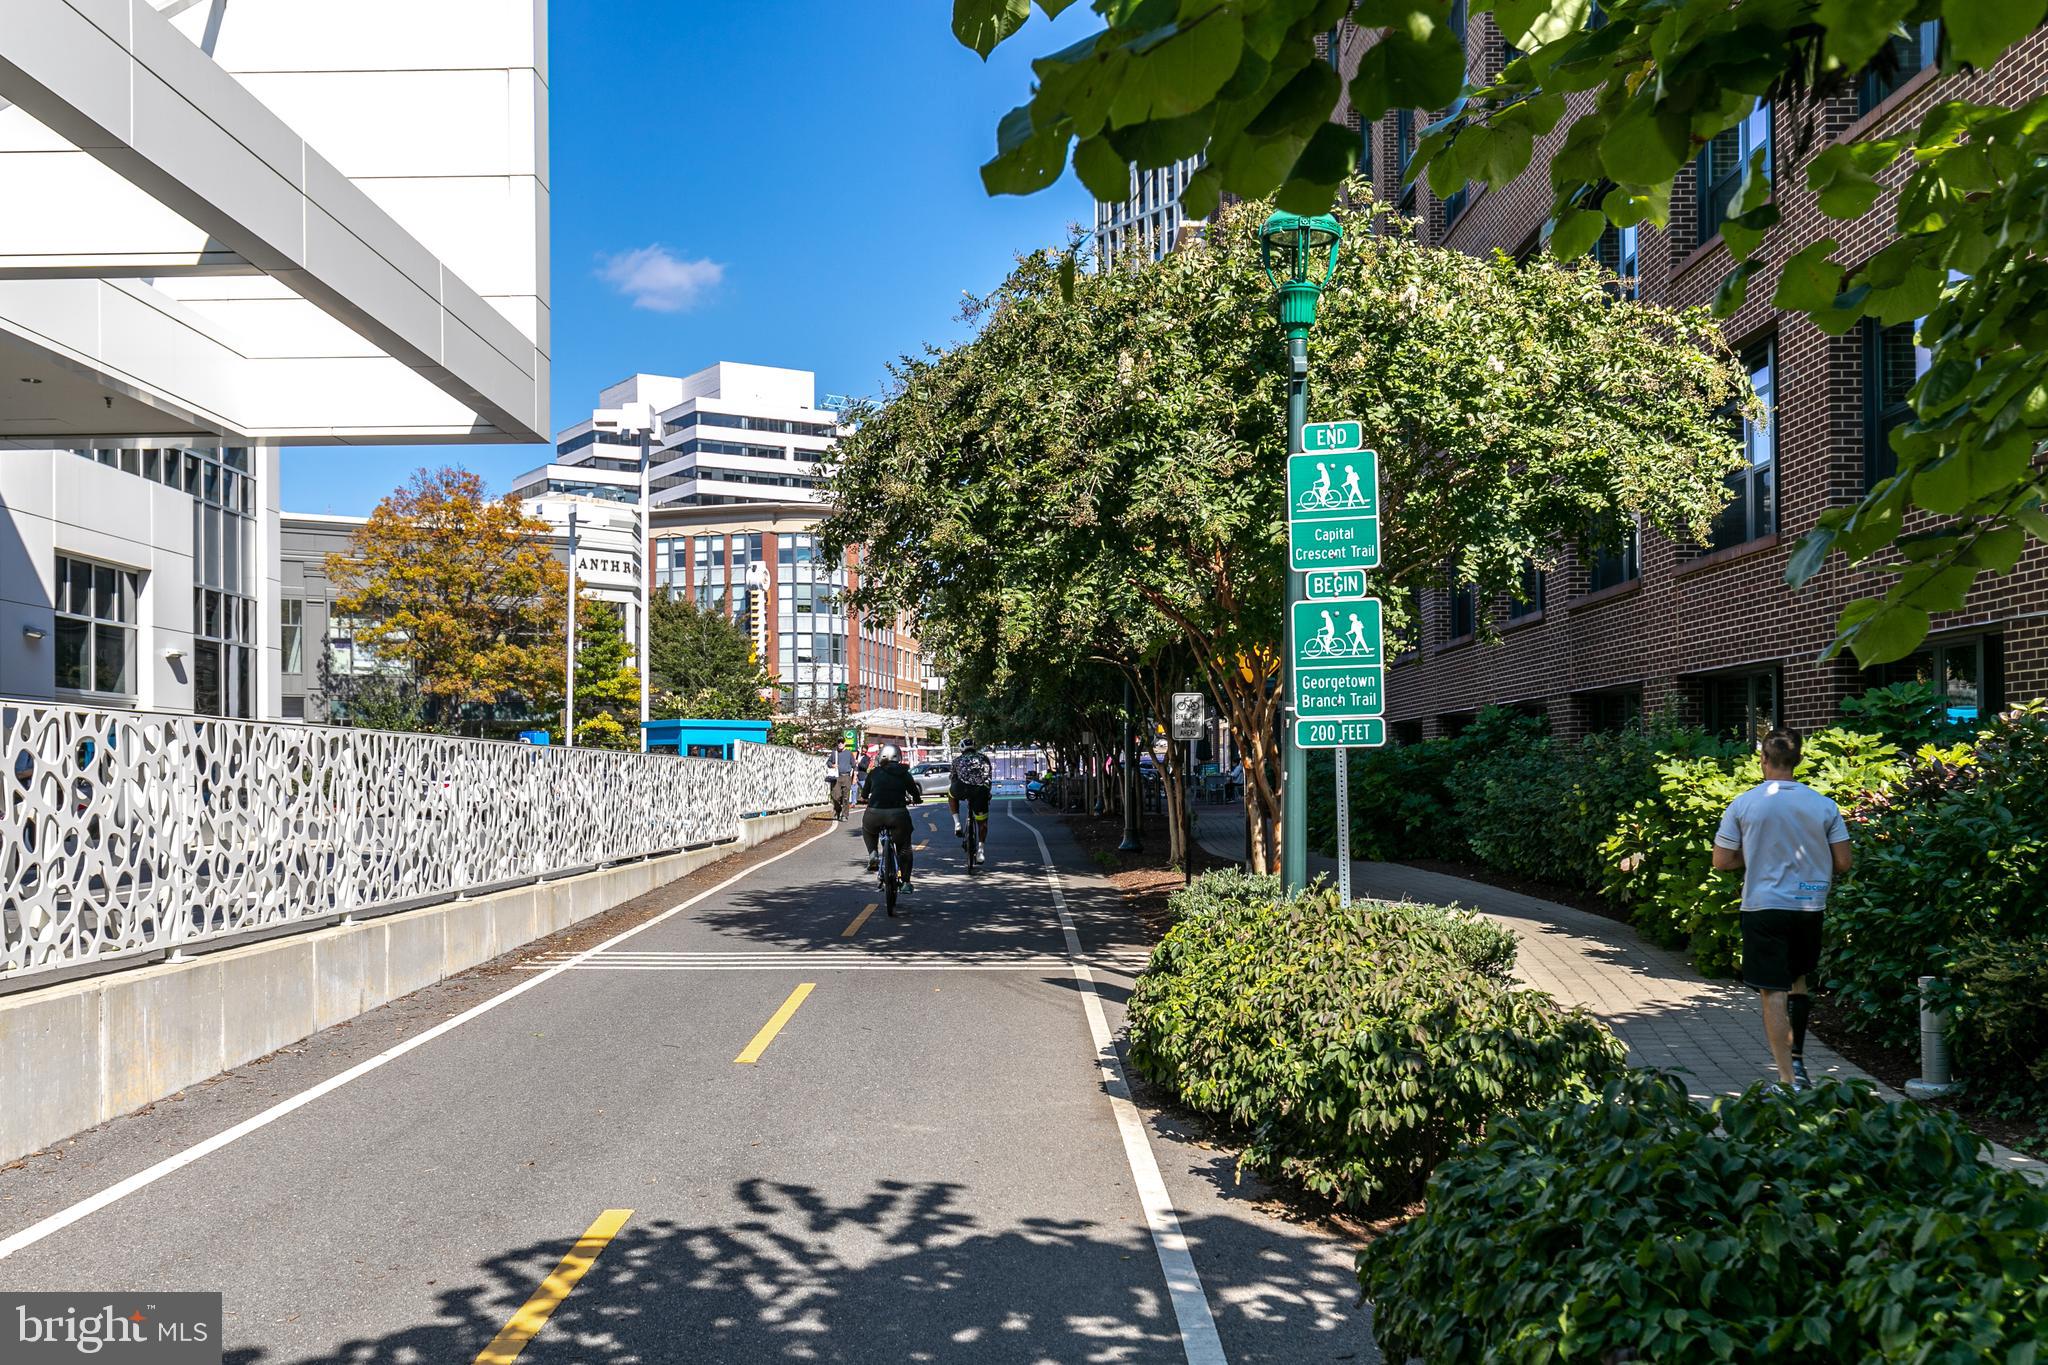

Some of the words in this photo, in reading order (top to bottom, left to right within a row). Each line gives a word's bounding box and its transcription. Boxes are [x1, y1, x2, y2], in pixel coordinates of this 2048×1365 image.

[1317, 428, 1347, 446] END
[1314, 527, 1354, 543] Capital
[1295, 547, 1346, 561] Crescent
[1350, 545, 1375, 558] Trail
[578, 557, 639, 575] ANTHR
[1314, 575, 1358, 594] BEGIN
[1302, 675, 1375, 692] Georgetown
[1302, 694, 1346, 708] Branch
[1349, 692, 1377, 706] Trail
[1310, 725, 1336, 742] 200
[1341, 723, 1371, 741] FEET
